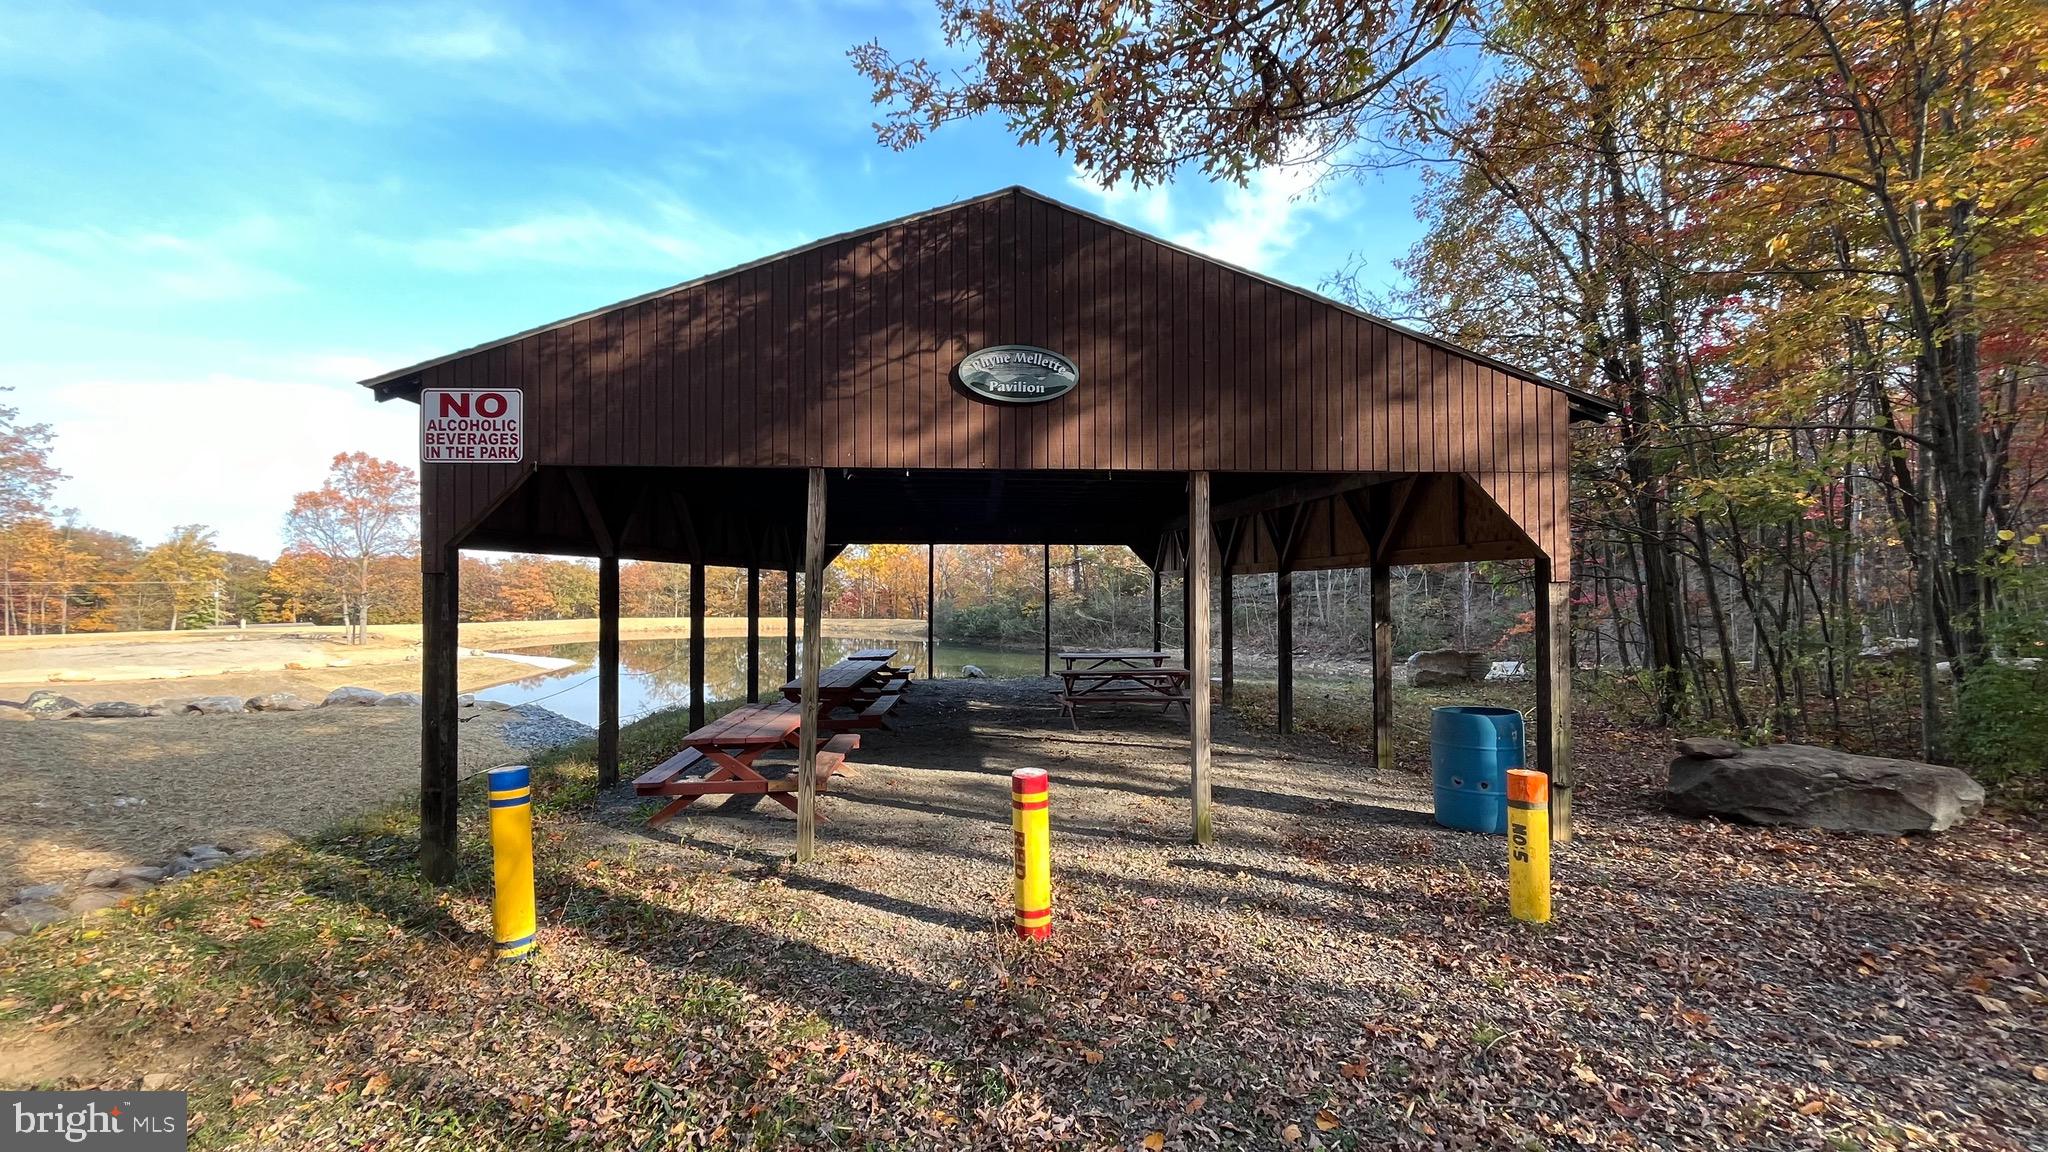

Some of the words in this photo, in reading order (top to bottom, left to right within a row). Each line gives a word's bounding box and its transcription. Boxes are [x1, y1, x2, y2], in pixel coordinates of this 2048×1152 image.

[1013, 352, 1066, 374] Mellette
[989, 381, 1045, 393] Pavilion
[439, 393, 508, 418] NO
[426, 419, 517, 432] ALCOHOLIC
[425, 433, 519, 445] BEVERAGES
[426, 446, 440, 459] IN
[446, 446, 475, 459] THE
[480, 446, 518, 459] PARK
